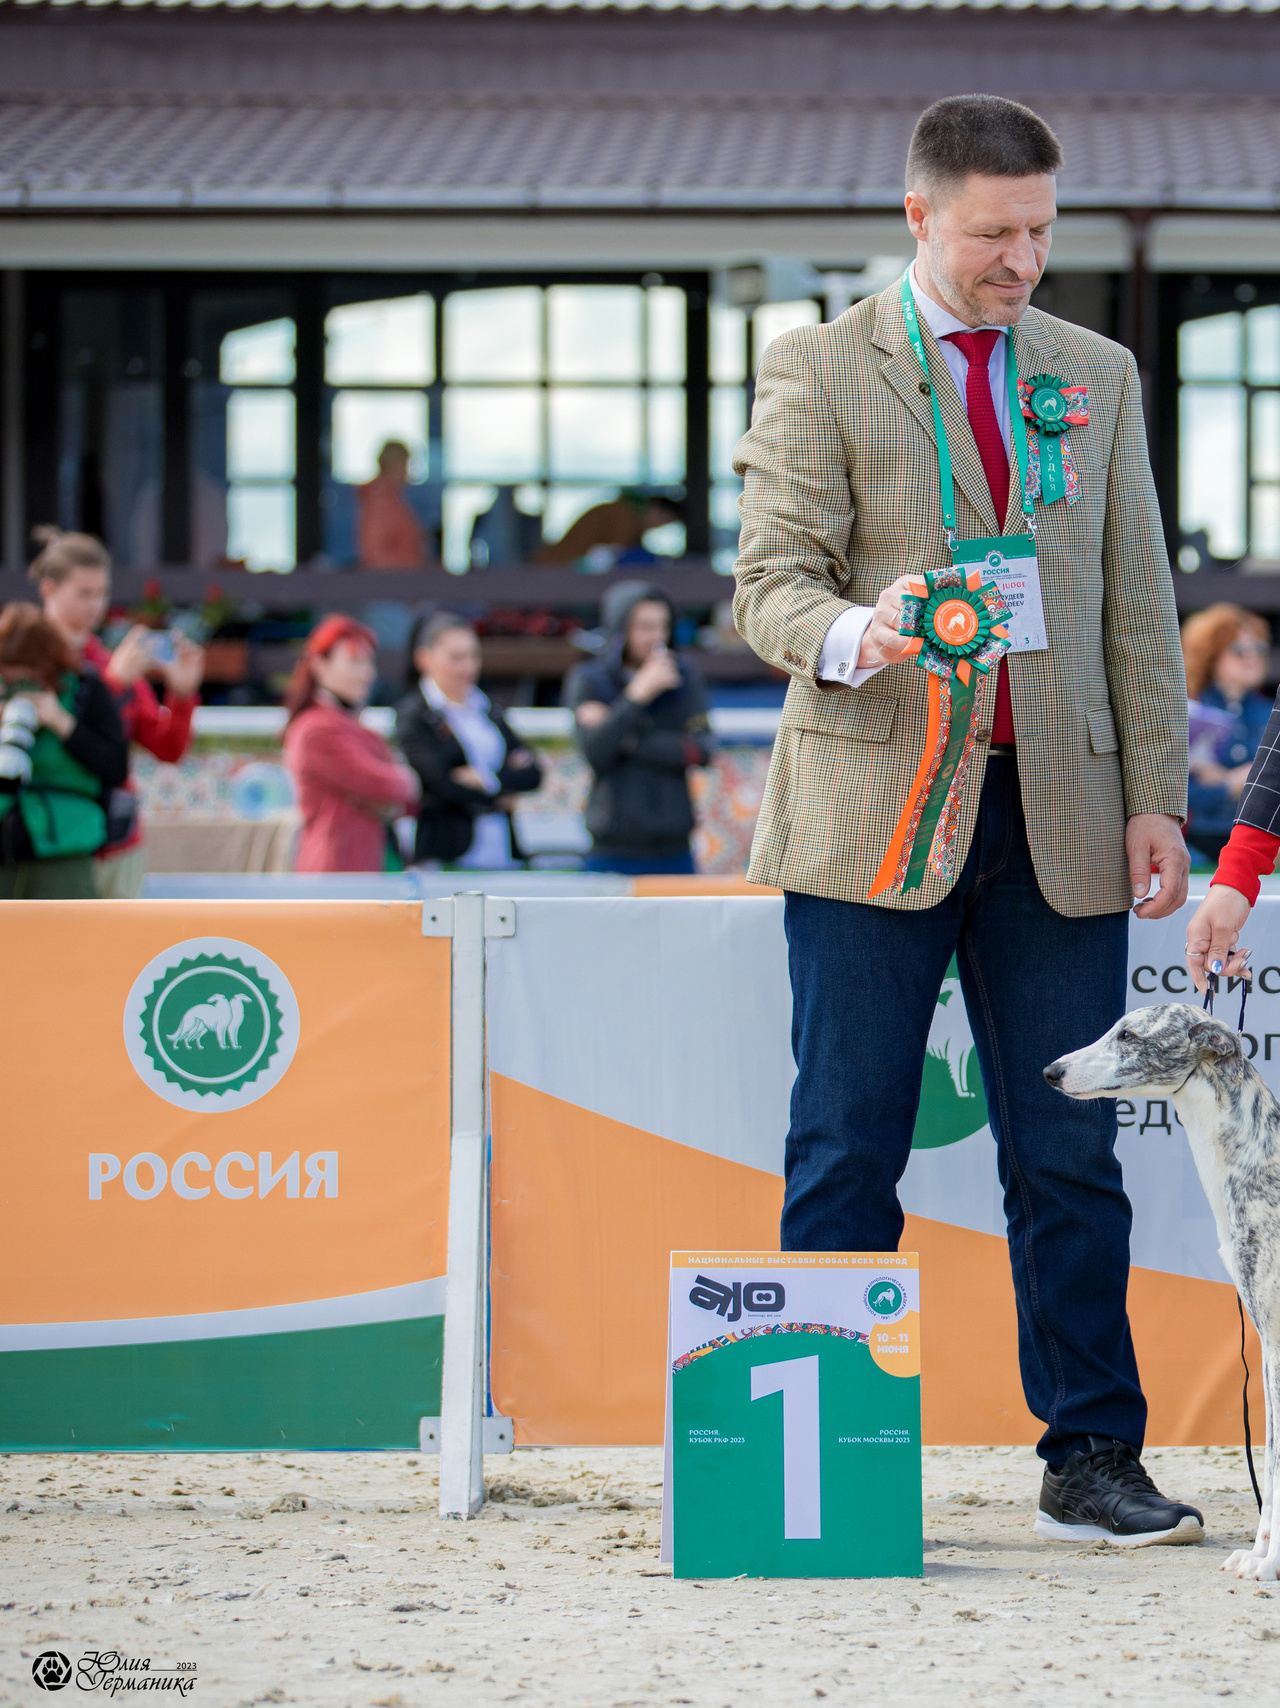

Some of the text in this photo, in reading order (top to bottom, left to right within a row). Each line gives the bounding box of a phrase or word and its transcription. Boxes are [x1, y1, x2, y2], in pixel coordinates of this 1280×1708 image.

[1046, 444, 1056, 492] СУДЬЯ
[982, 568, 1010, 576] РОССИЯ
[1002, 581, 1026, 591] JUDGE
[88, 1150, 339, 1200] РОССИЯ
[877, 1333, 889, 1342] 10
[898, 1333, 909, 1342] 11
[877, 1345, 909, 1353] ИЮНЯ
[750, 1354, 822, 1540] 1
